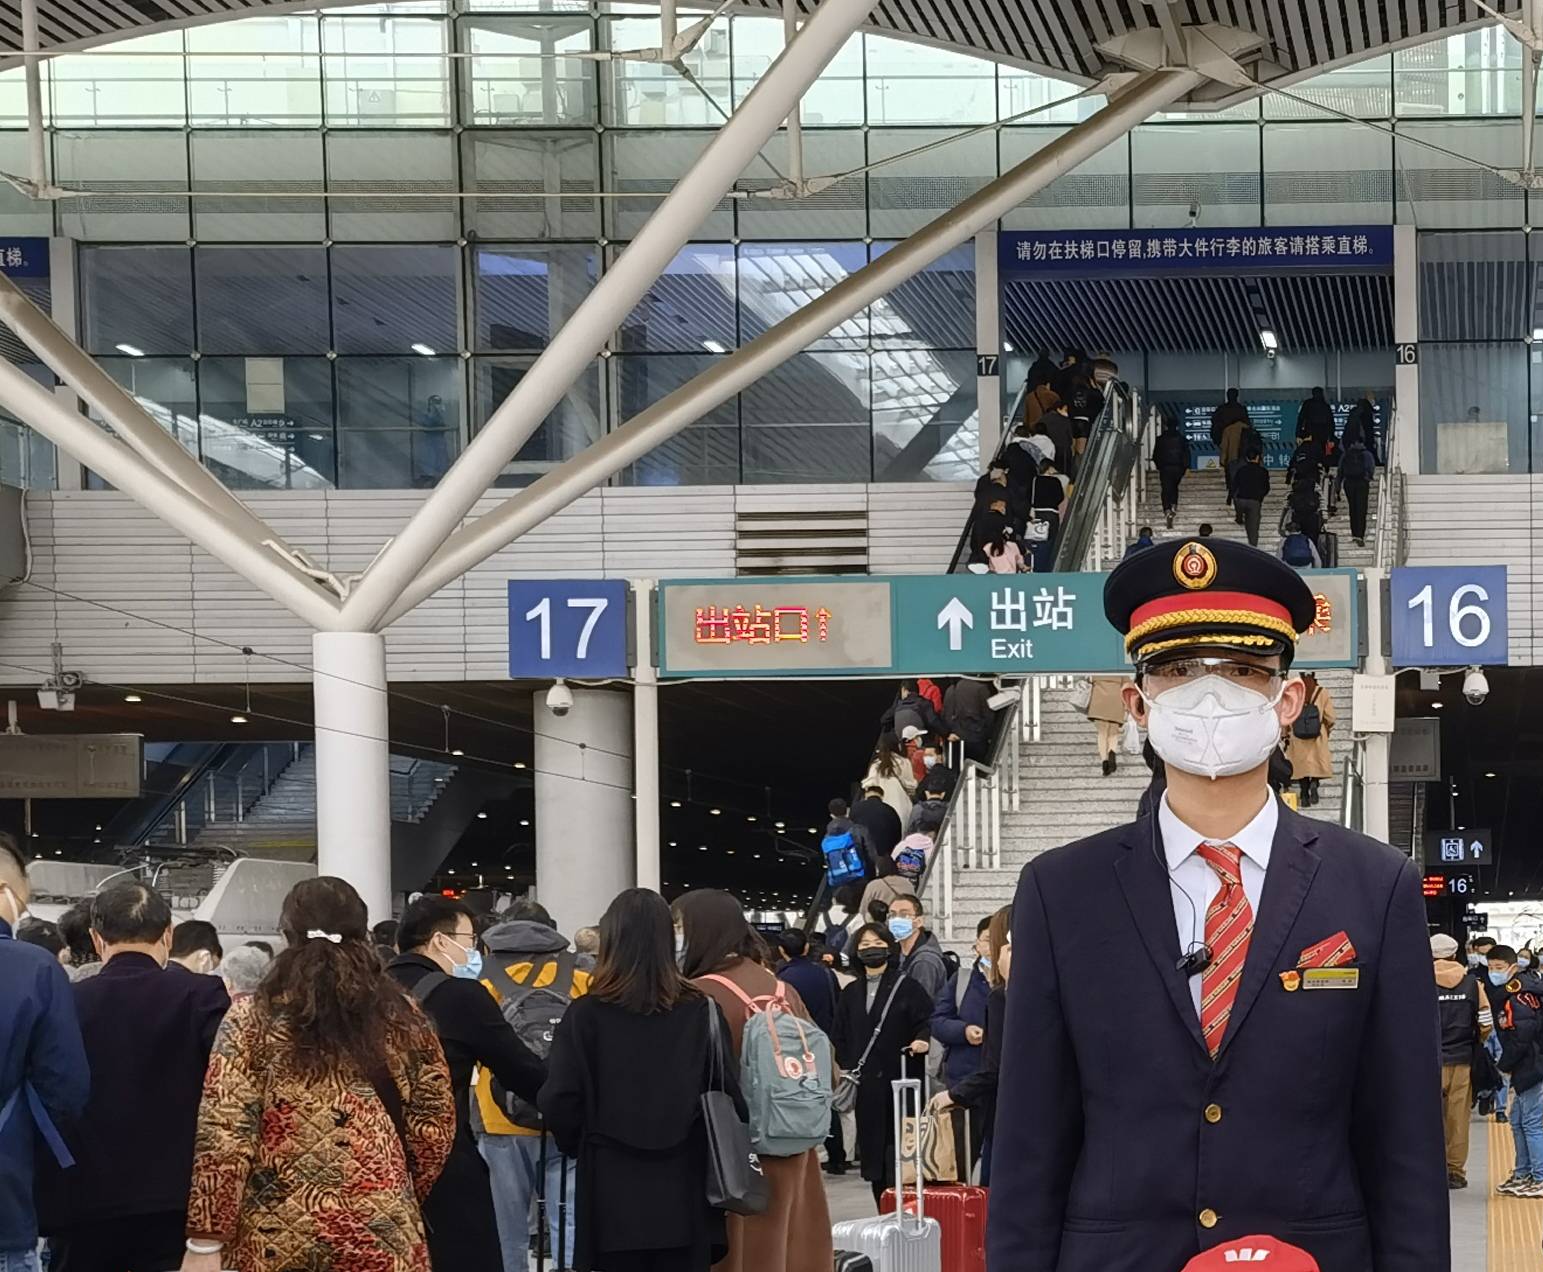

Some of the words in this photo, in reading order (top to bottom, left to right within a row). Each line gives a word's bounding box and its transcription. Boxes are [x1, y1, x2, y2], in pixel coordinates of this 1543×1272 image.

[979, 356, 997, 375] 17
[1396, 344, 1416, 363] 16
[696, 604, 808, 644] 出站口
[990, 586, 1077, 632] 出站
[1407, 583, 1491, 648] 16
[525, 598, 609, 660] 17
[991, 638, 1034, 659] Exit
[1448, 878, 1468, 893] 16
